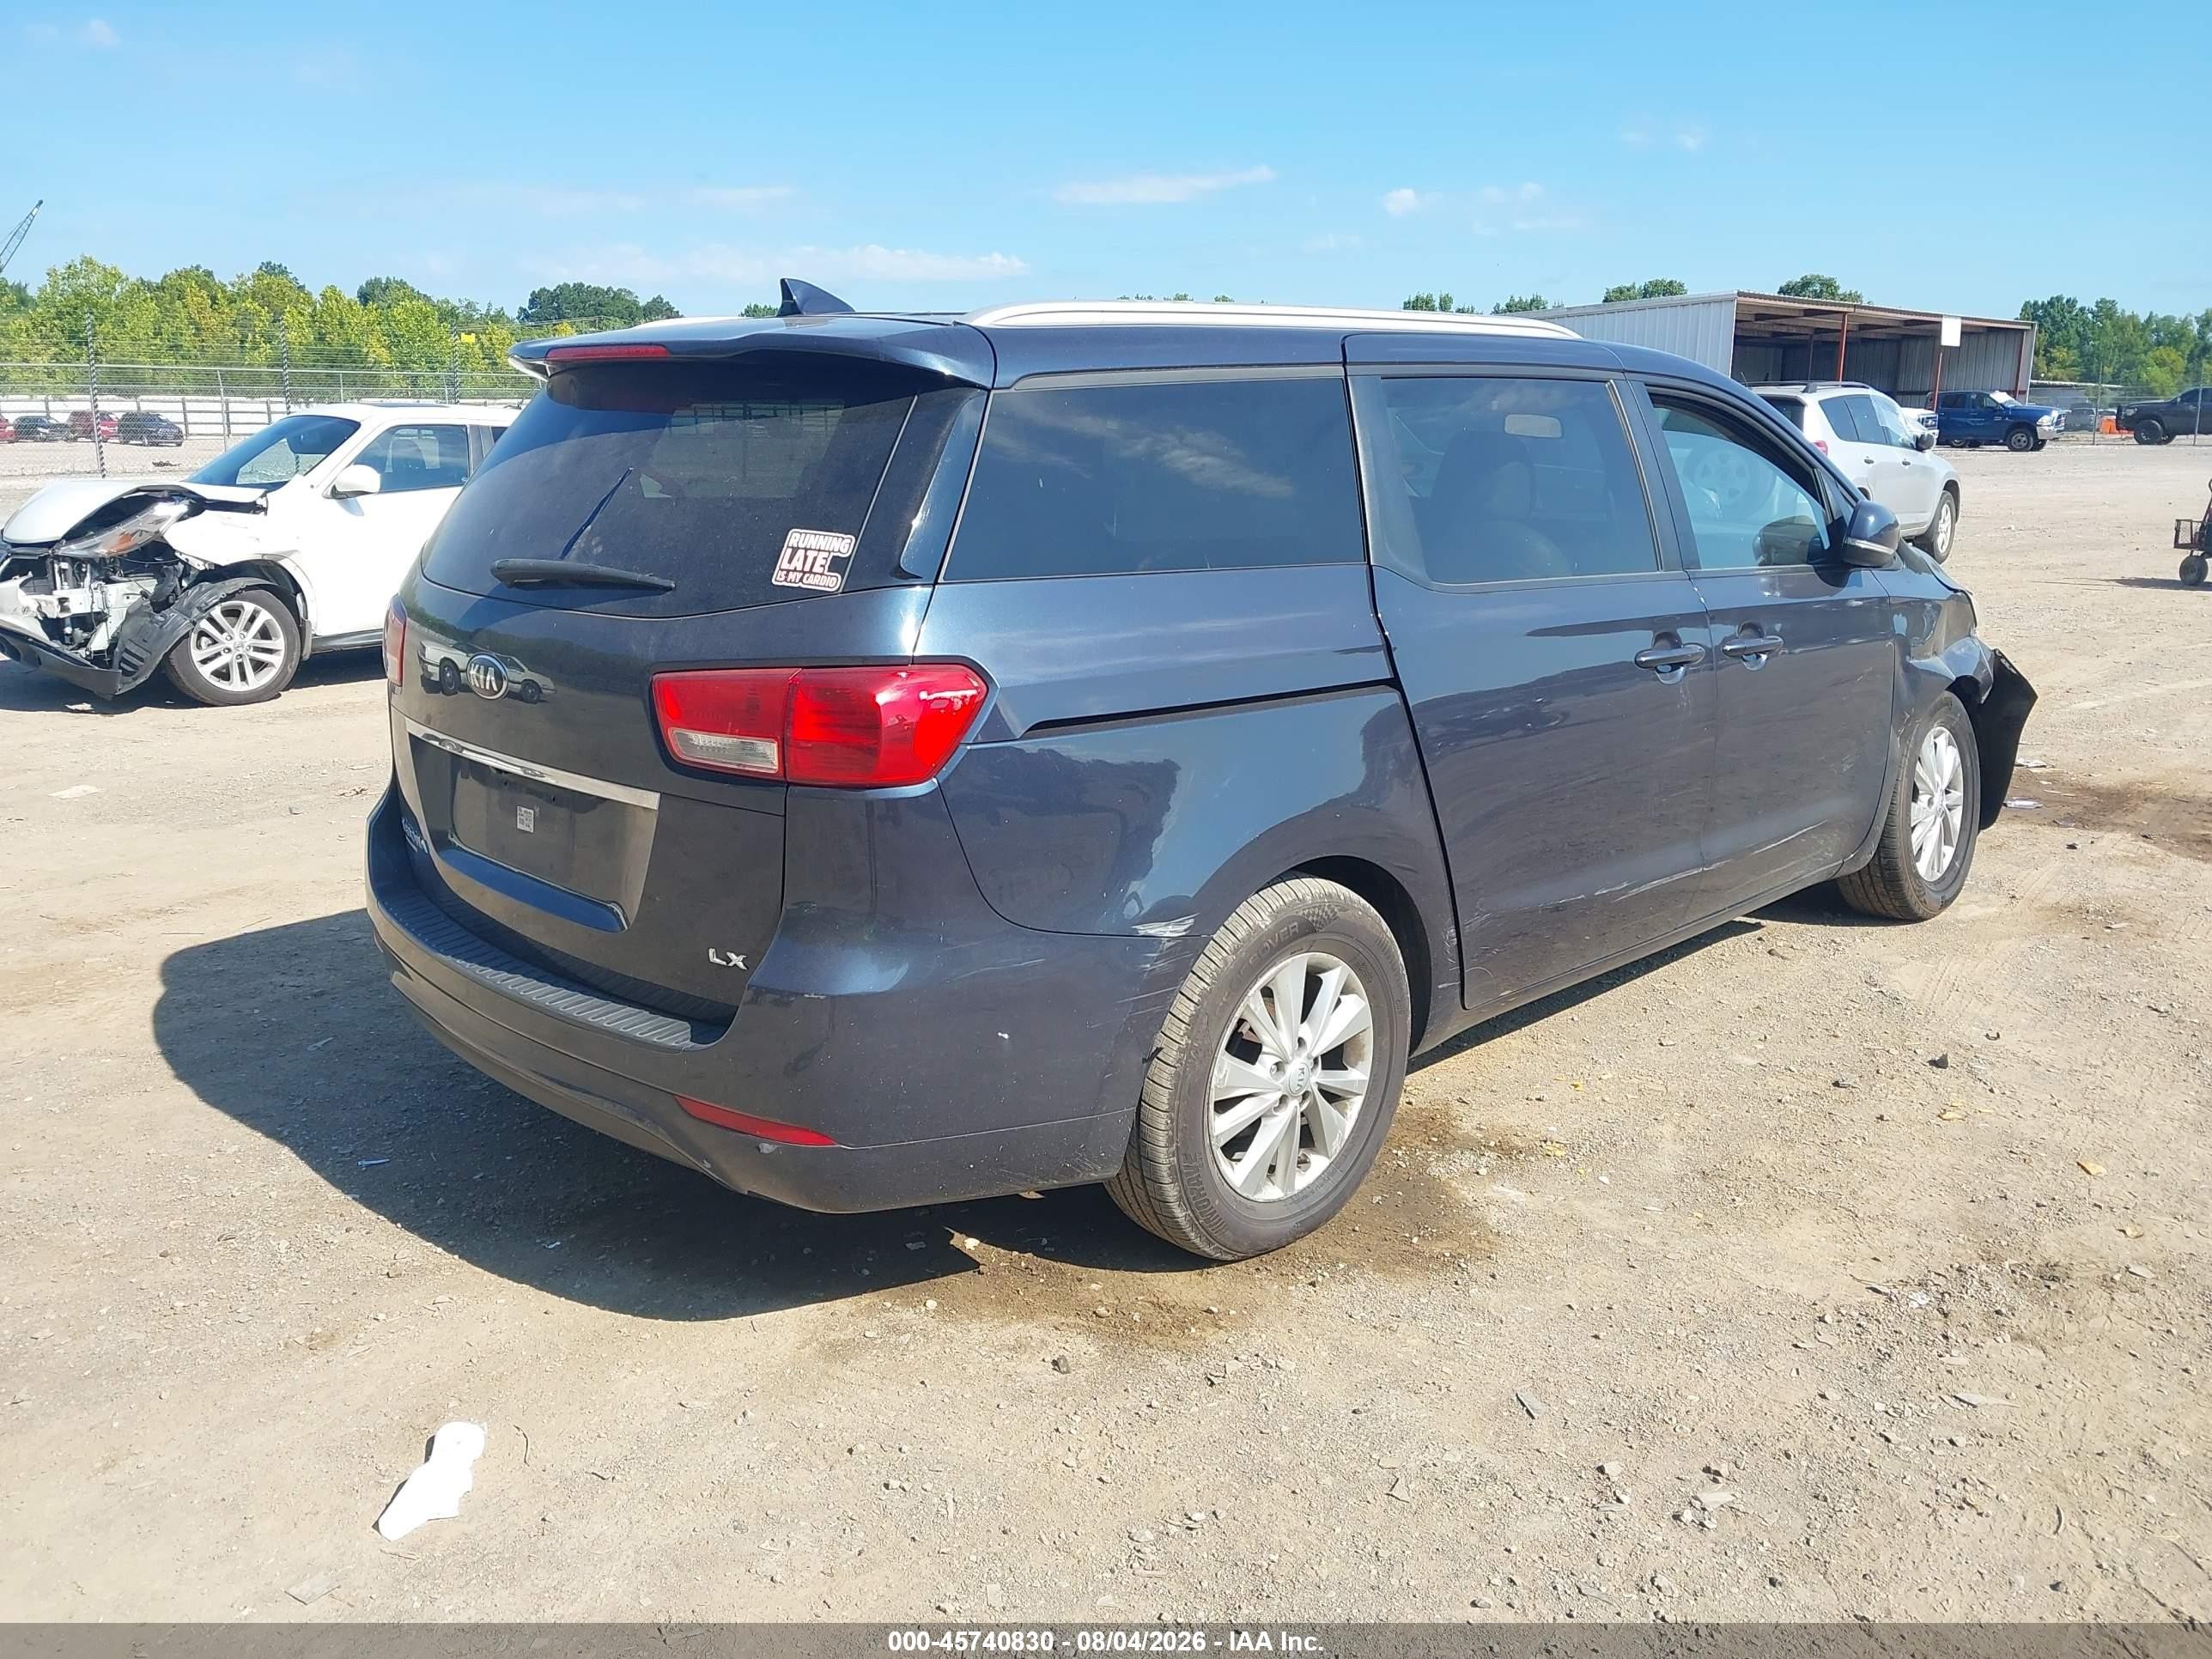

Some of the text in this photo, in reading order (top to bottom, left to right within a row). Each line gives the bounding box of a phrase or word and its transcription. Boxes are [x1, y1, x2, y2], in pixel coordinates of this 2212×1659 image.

[787, 532, 852, 554] RUNNING
[780, 547, 830, 574] LATE
[775, 570, 838, 588] IS MY CARDIO
[469, 662, 499, 693] KIA
[708, 947, 748, 970] LX
[1295, 1066, 1305, 1093] KIA
